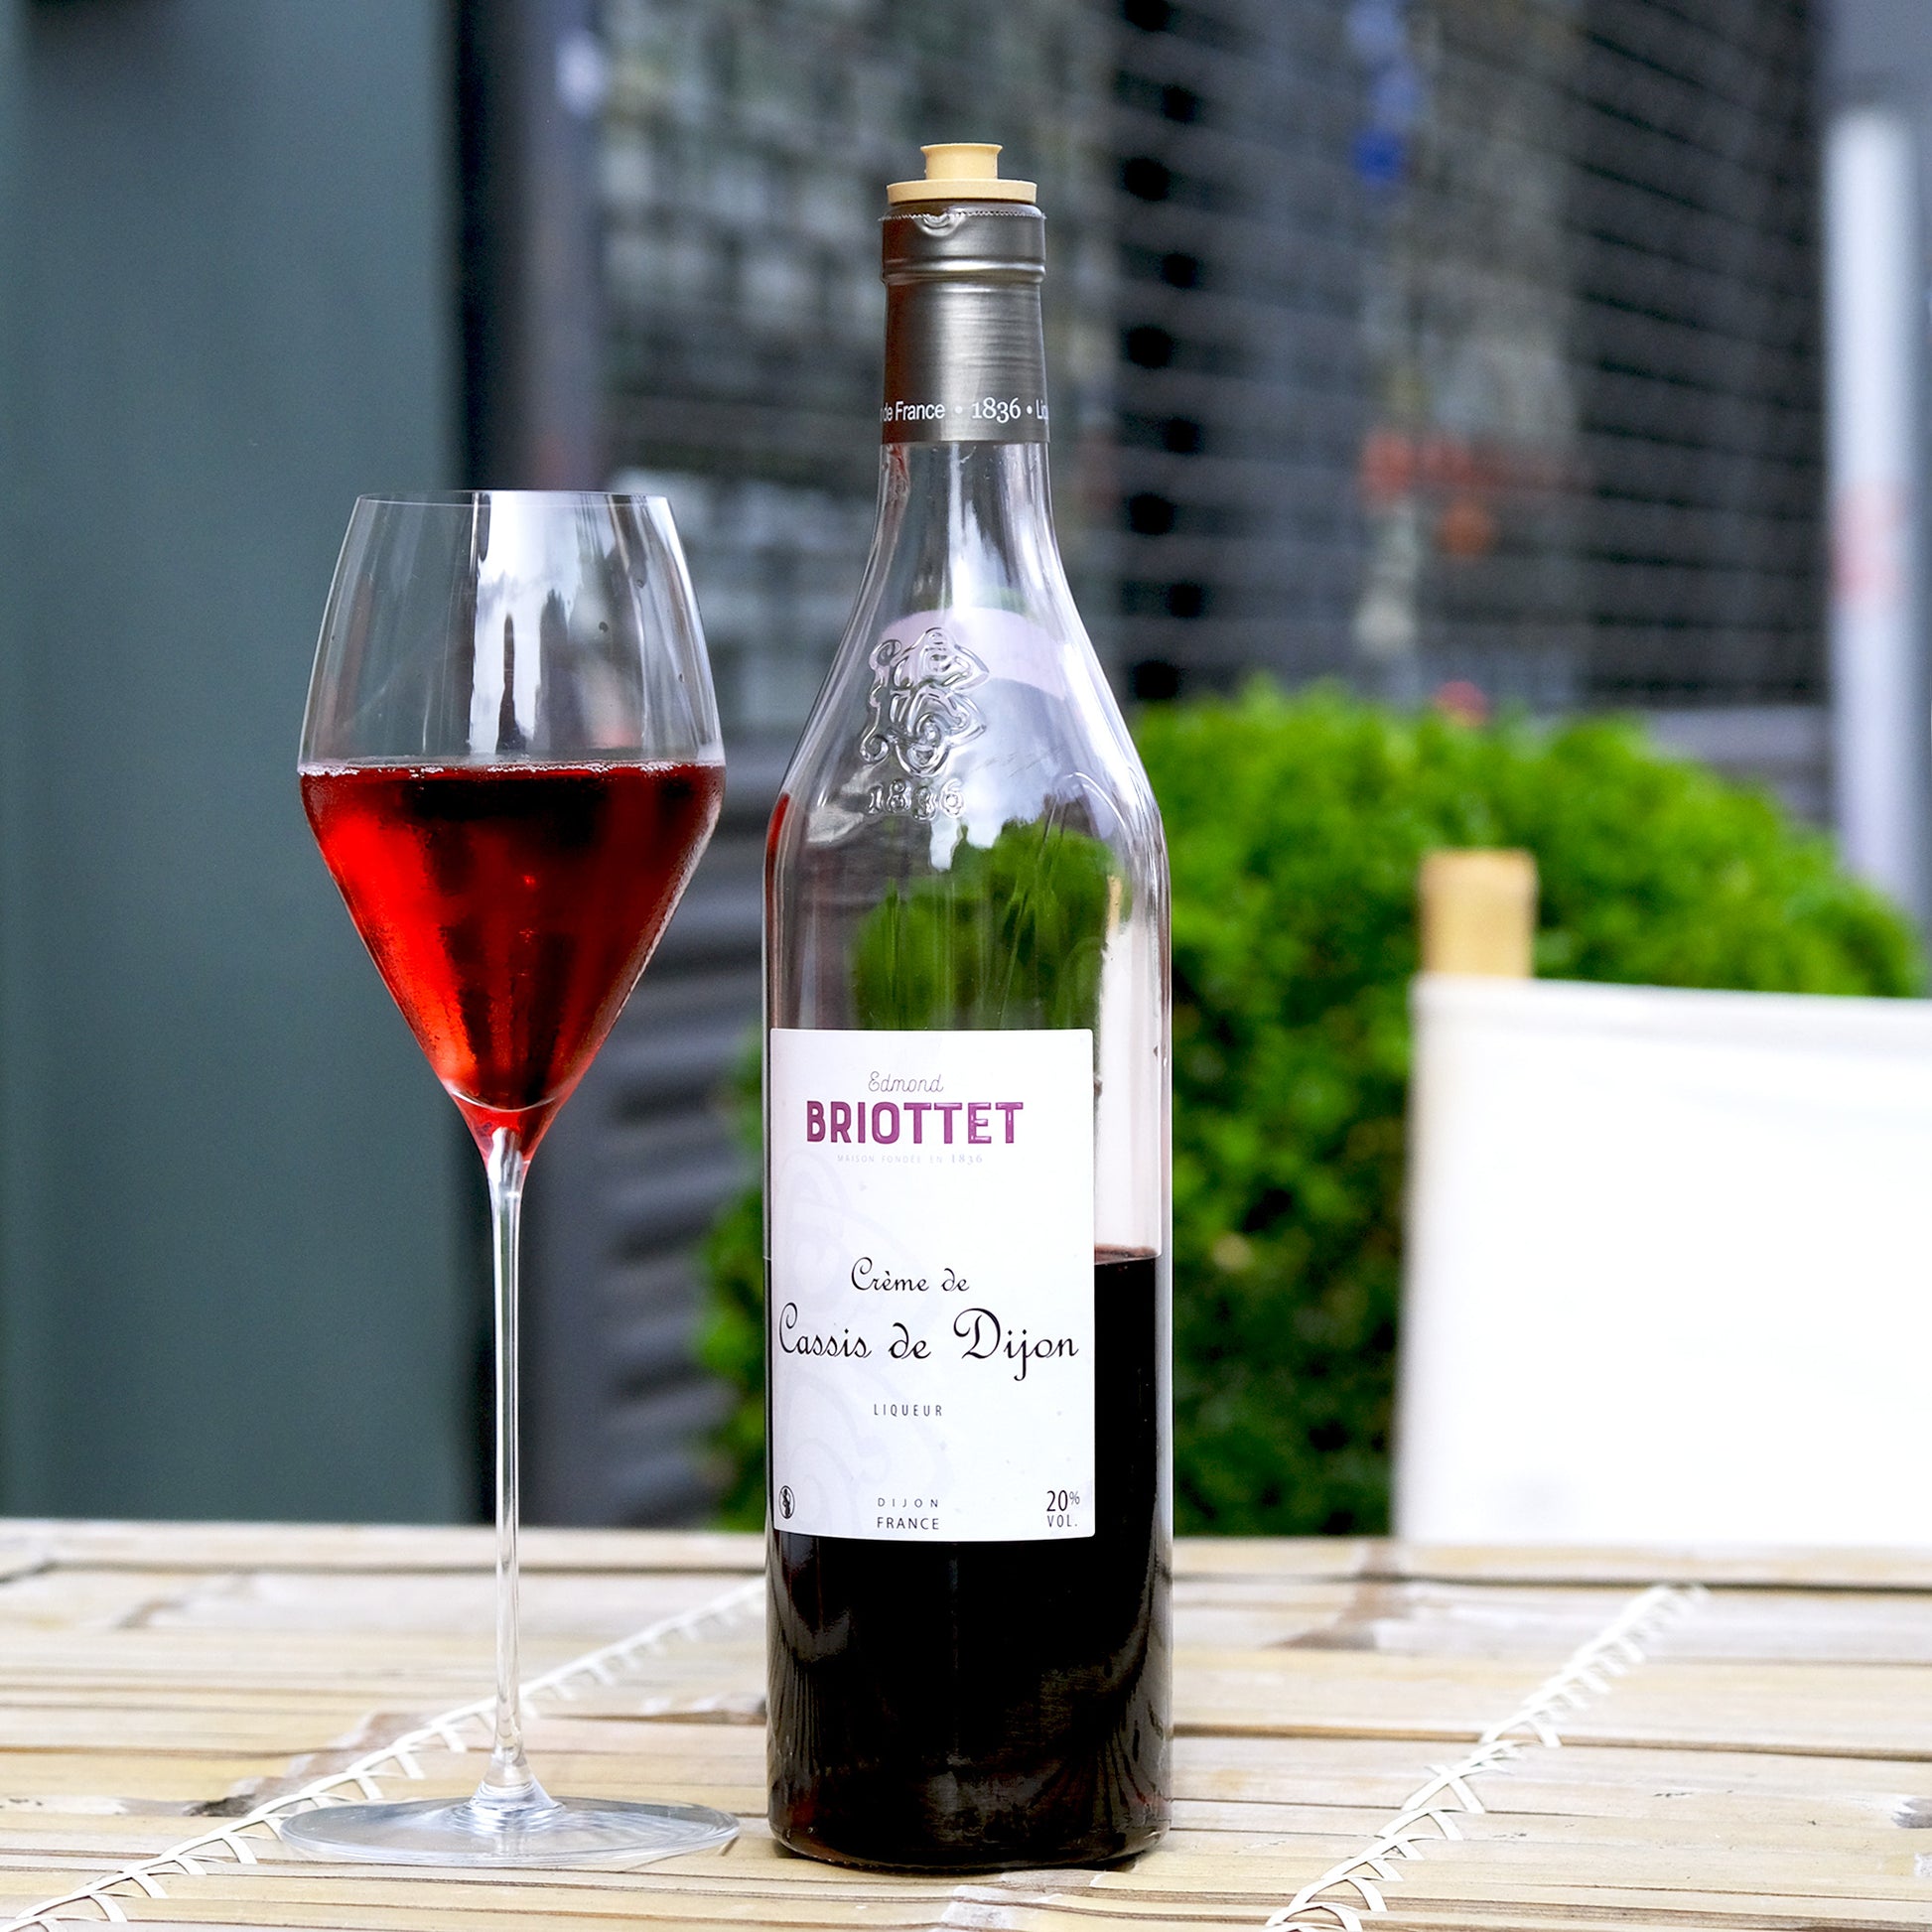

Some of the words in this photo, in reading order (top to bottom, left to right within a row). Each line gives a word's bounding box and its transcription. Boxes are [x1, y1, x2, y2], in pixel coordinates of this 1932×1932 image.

[895, 400, 945, 422] France
[971, 396, 1022, 424] 1836
[868, 778, 965, 821] 1836
[868, 1070, 944, 1093] Edmond
[806, 1100, 1024, 1144] BRIOTTET
[836, 1154, 875, 1164] MAISON
[929, 1154, 943, 1164] EN
[951, 1154, 984, 1166] 1836
[851, 1256, 929, 1292] Crème
[940, 1268, 970, 1292] de
[778, 1302, 873, 1358] Cassis
[888, 1321, 931, 1359] de
[953, 1307, 1079, 1382] Dijon
[873, 1403, 943, 1418] LIQUEUR
[877, 1497, 939, 1509] DIJON
[1045, 1489, 1081, 1512] 20%
[877, 1516, 939, 1531] FRANCE
[1046, 1514, 1079, 1528] VOL.
